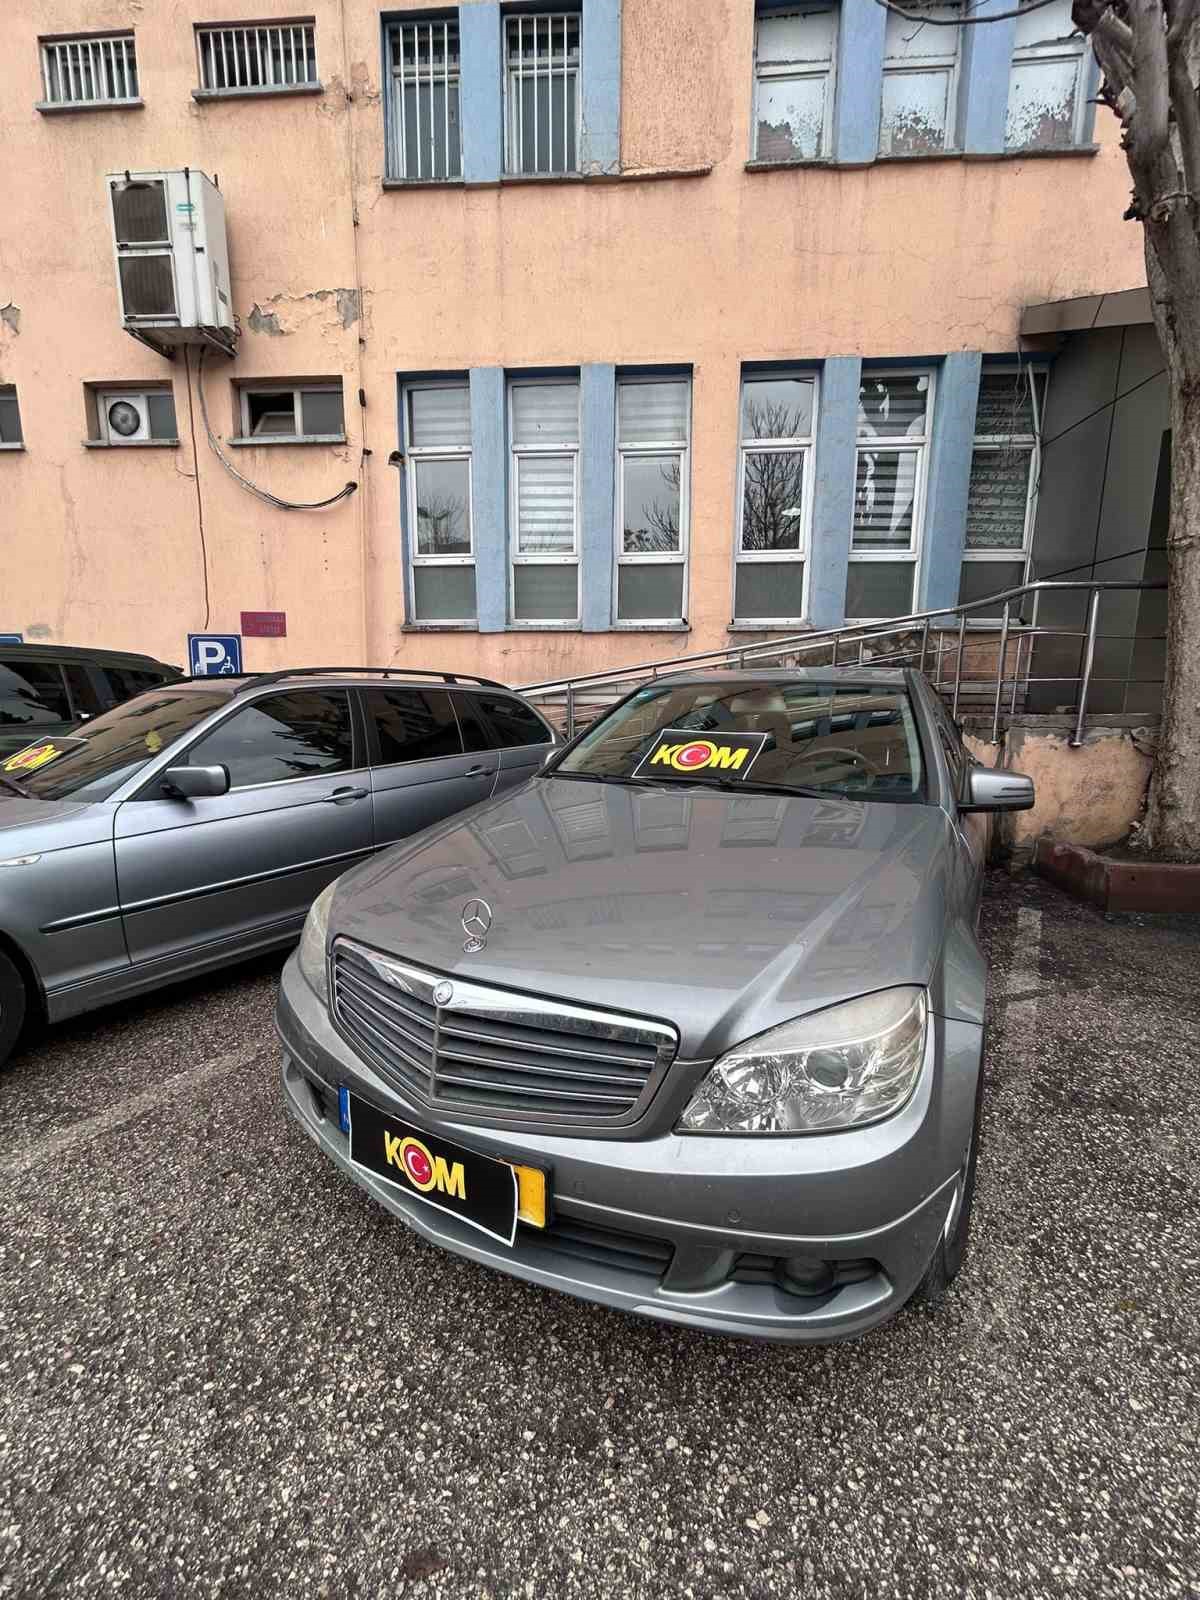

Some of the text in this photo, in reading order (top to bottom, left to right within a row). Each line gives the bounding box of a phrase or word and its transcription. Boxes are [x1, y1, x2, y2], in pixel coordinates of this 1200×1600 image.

[198, 641, 225, 675] P
[650, 740, 750, 771] KOM
[384, 1130, 466, 1200] KOM
